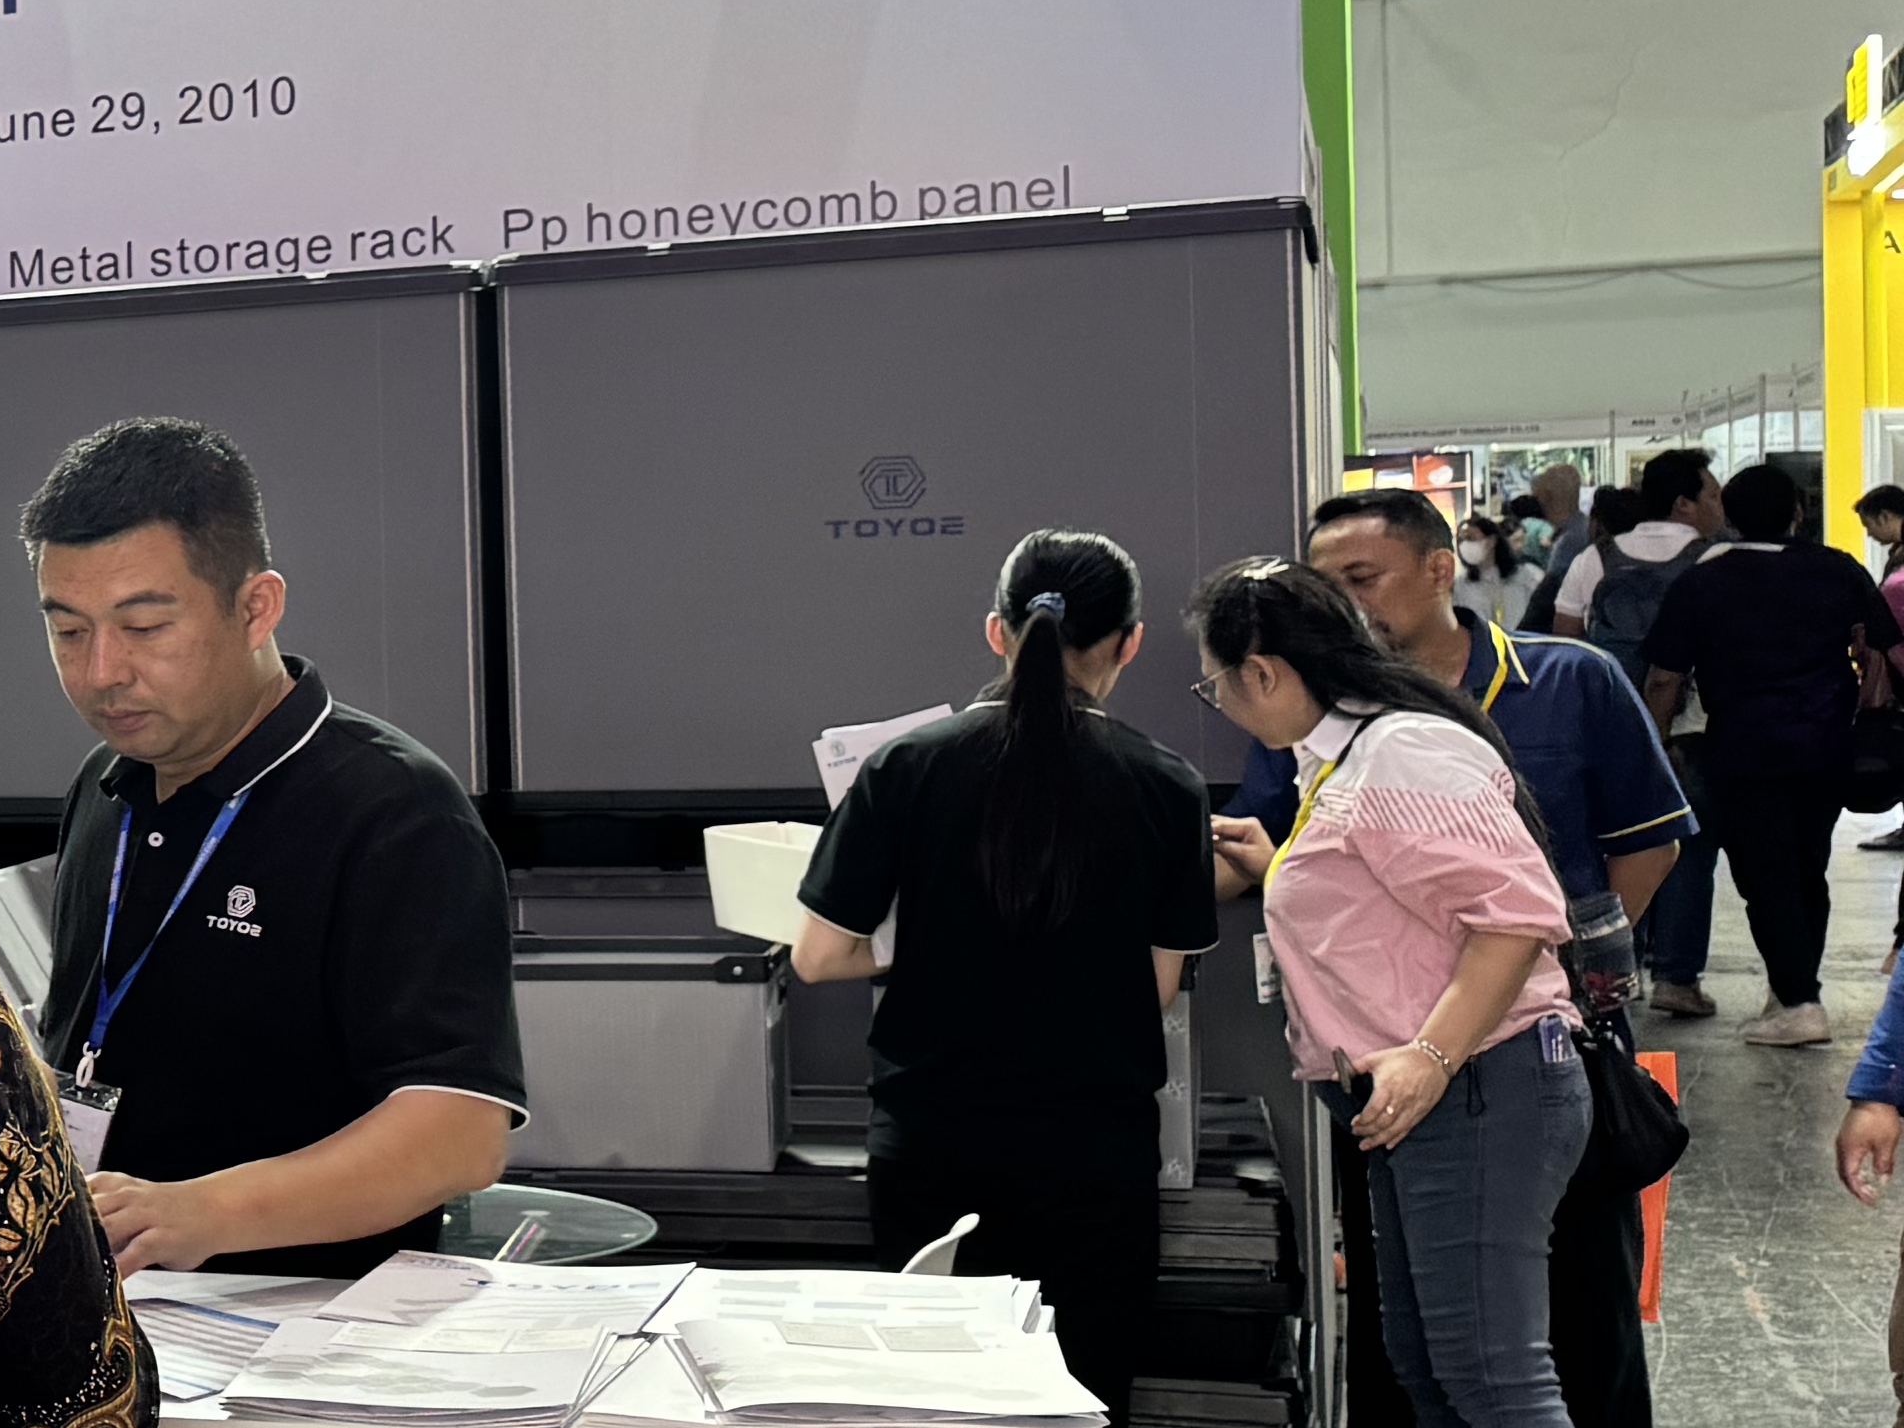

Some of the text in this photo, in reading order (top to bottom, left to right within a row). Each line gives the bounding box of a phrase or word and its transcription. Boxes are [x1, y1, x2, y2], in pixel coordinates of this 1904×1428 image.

[89, 91, 162, 137] 29,
[177, 75, 298, 127] 2010
[9, 240, 134, 290] Metal
[149, 229, 332, 280] storage
[349, 215, 456, 264] rack
[503, 206, 569, 252] Pp
[585, 180, 899, 244] honeycomb
[918, 164, 1072, 222] panel
[825, 517, 965, 539] TOYOE
[207, 915, 262, 937] TOYOE
